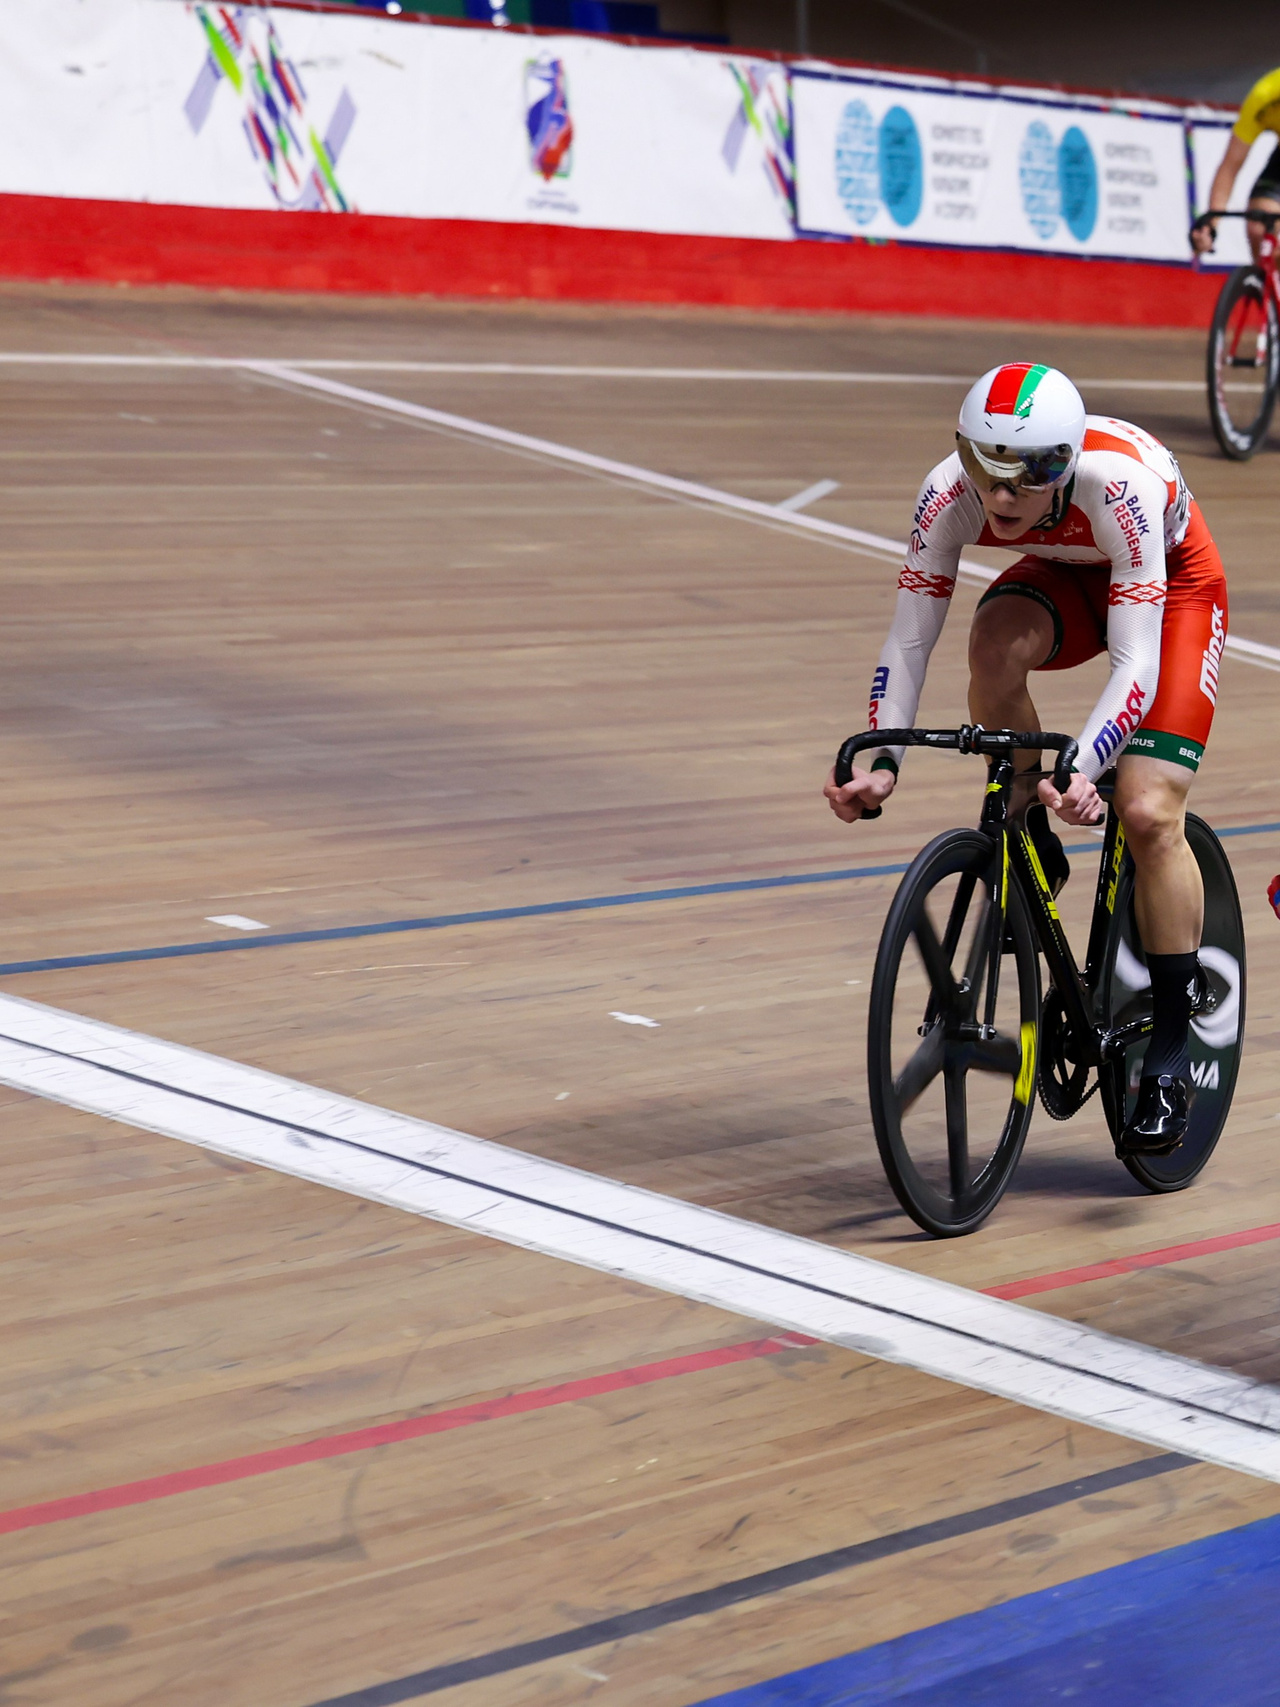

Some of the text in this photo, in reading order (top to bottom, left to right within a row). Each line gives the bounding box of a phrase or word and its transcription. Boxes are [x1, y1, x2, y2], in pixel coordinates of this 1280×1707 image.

[914, 484, 938, 524] BANK
[919, 480, 965, 533] RESHENIE
[1126, 495, 1150, 536] BANK
[1113, 503, 1143, 569] RESHENIE
